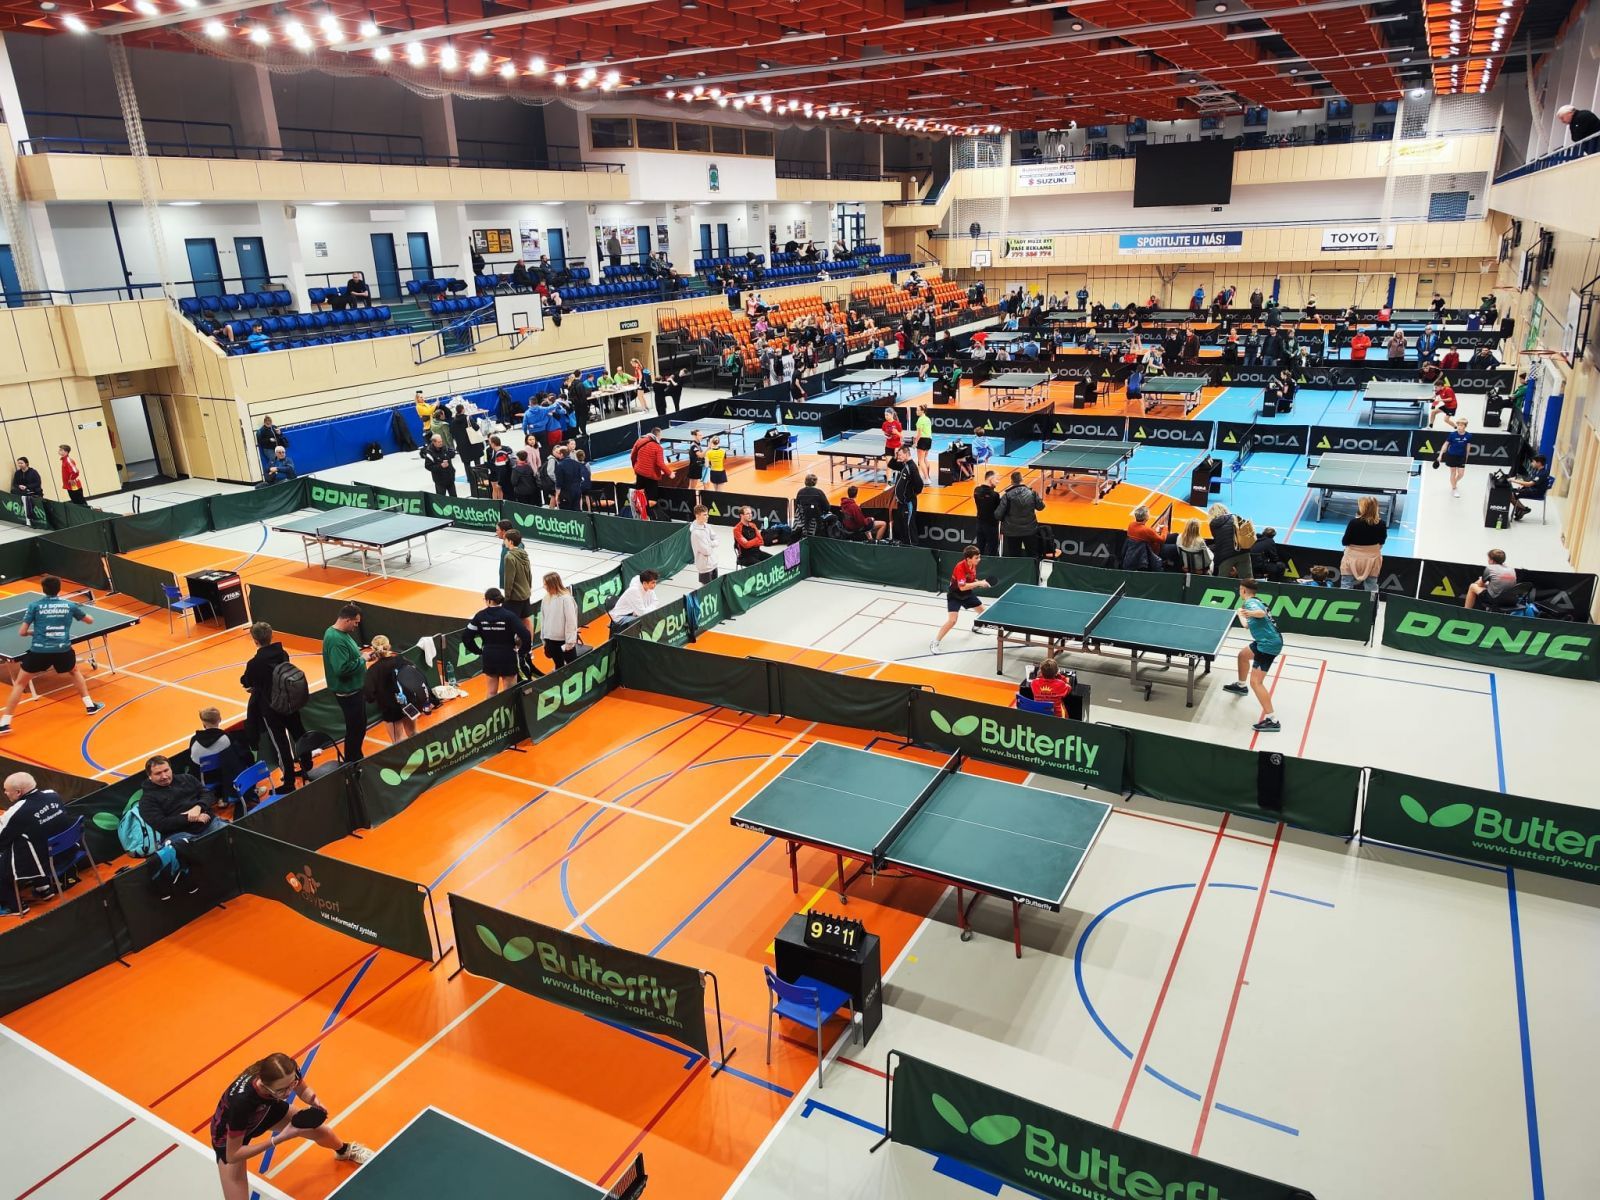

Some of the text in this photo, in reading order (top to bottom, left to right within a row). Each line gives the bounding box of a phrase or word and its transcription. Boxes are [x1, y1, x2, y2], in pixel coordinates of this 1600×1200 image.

[1036, 177, 1067, 185] SUZUKI
[1136, 233, 1226, 247] SPORTUJTE U NÁS!
[1056, 368, 1092, 377] JOOLA
[1233, 373, 1277, 382] JOOLA
[1453, 378, 1506, 388] JOOLA
[733, 407, 773, 418] JOOLA
[1065, 424, 1119, 436] JOOLA
[1149, 428, 1205, 441] JOOLA
[1331, 437, 1399, 452] JOOLA
[453, 505, 501, 523] Butterfly
[534, 515, 585, 537] Butterfly
[918, 526, 978, 544] JOOL
[1396, 611, 1592, 661] DONIC
[536, 652, 615, 720] DONI
[426, 704, 516, 769] Butterfly
[980, 717, 1099, 769] Butterfly
[981, 746, 1100, 776] www.butterfly-world.com
[34, 804, 50, 819] Post
[1025, 898, 1052, 911] Butterfly
[810, 921, 855, 946] 9 2 2 11
[535, 941, 678, 1018] Butterfly
[542, 975, 683, 1030] www.butterfly-world.com
